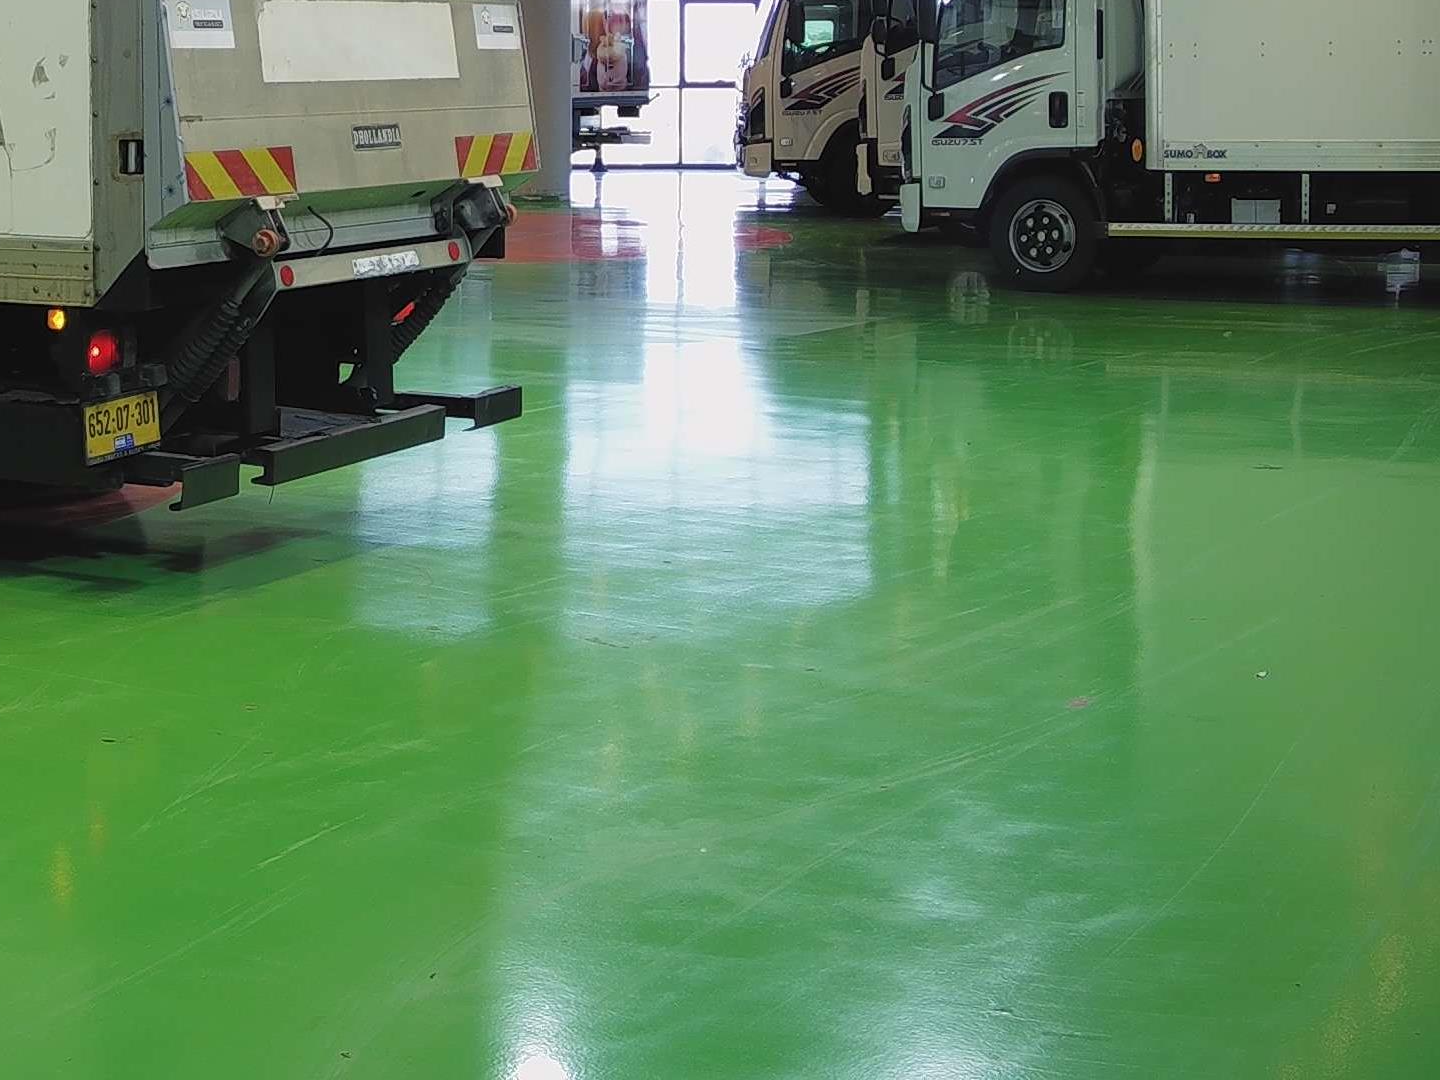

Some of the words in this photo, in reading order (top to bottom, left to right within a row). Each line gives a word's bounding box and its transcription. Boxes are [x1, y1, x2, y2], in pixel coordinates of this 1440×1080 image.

[352, 127, 401, 146] DHOLLANDIA
[1163, 149, 1194, 159] SUMO
[1206, 149, 1228, 159] BOX
